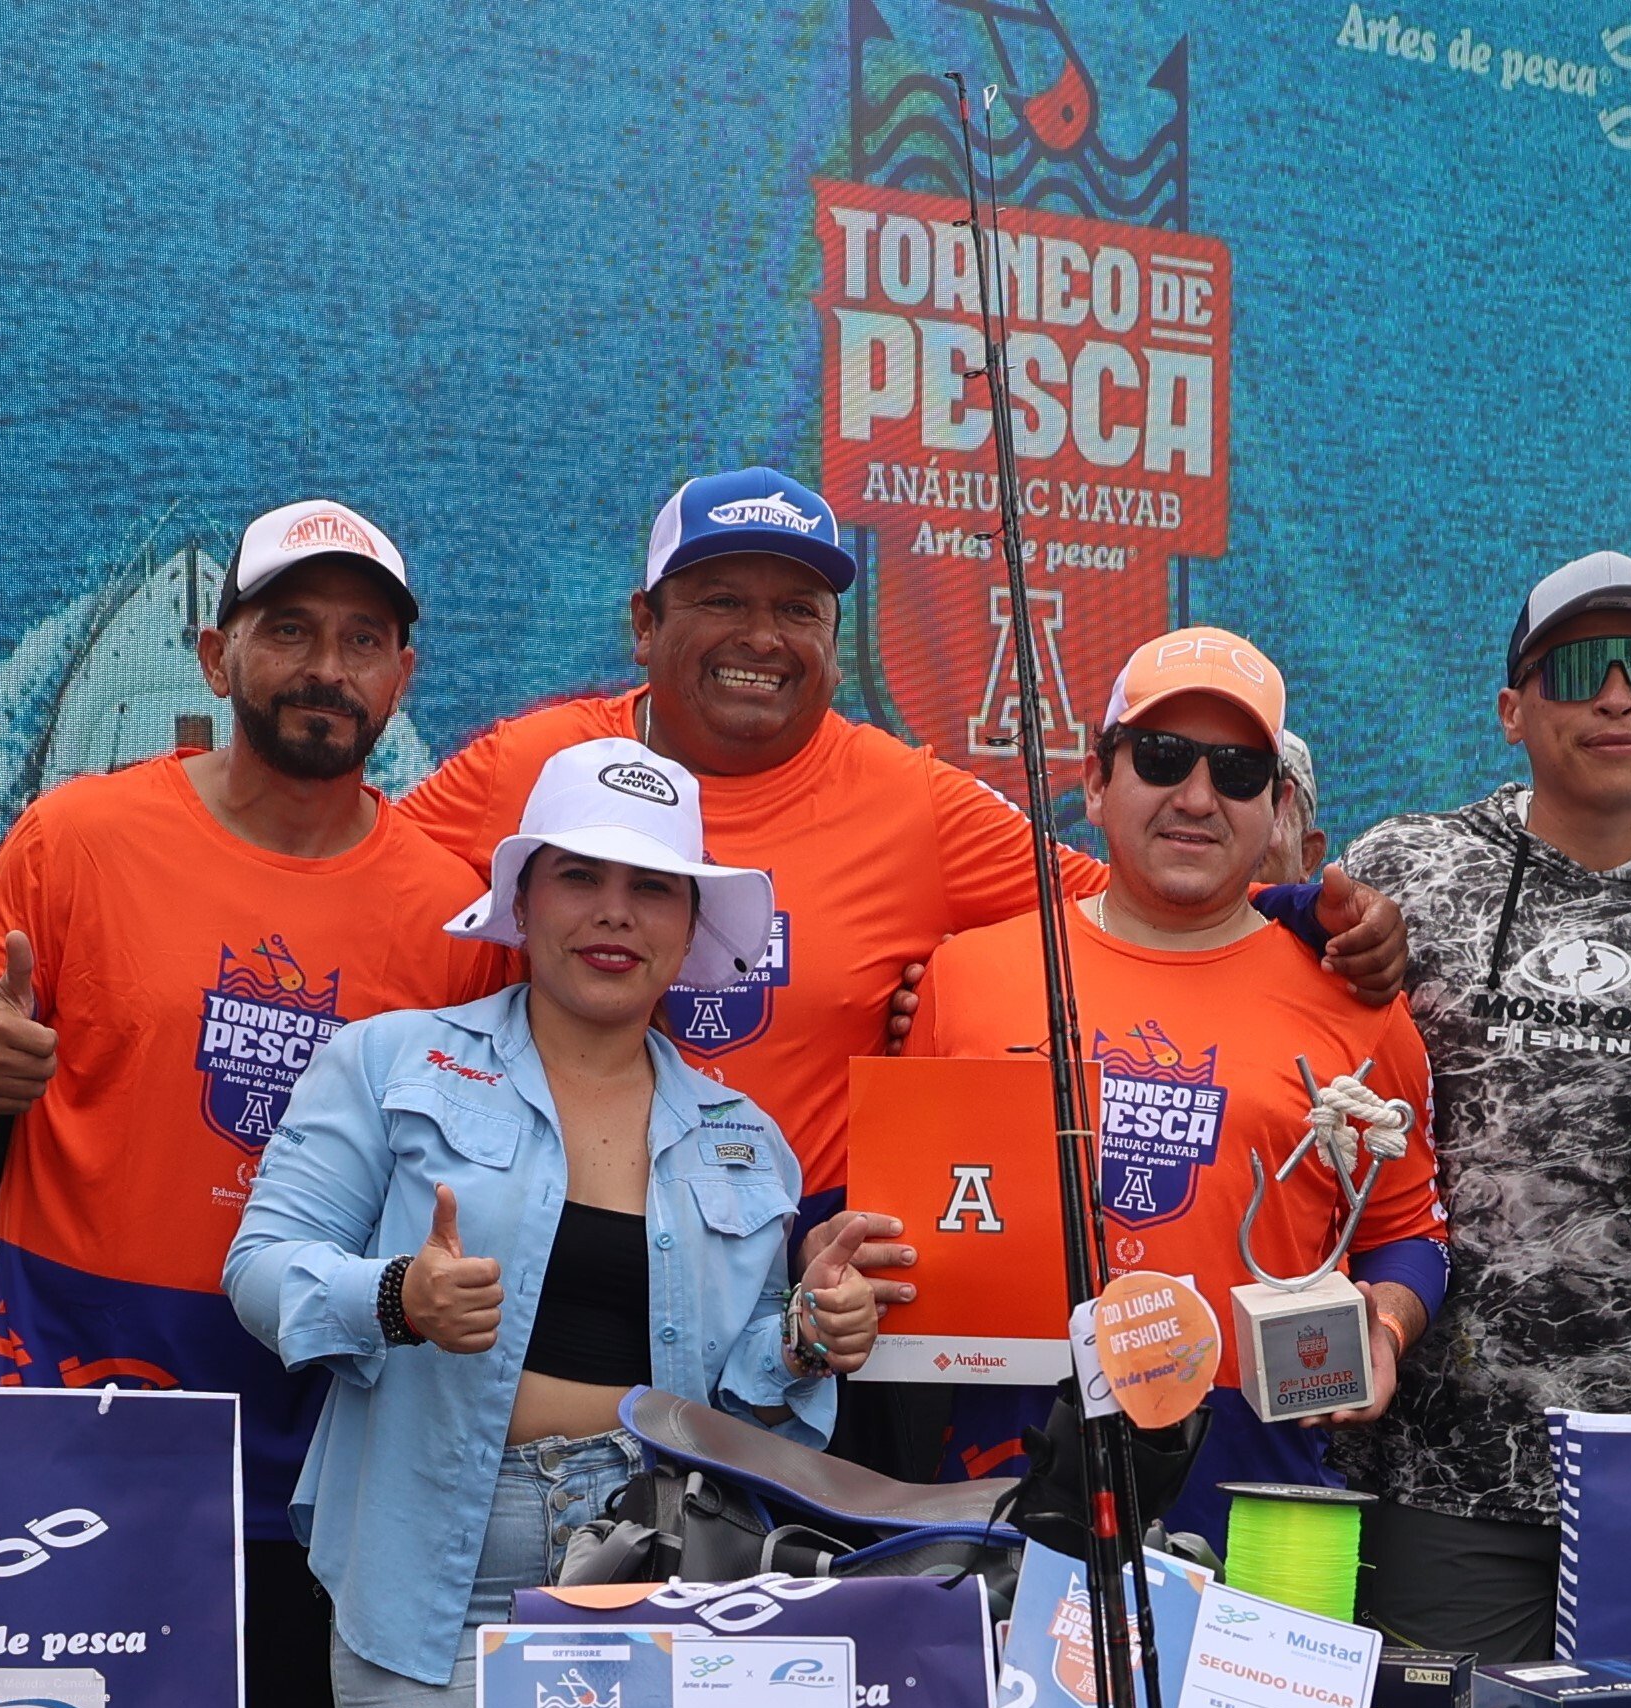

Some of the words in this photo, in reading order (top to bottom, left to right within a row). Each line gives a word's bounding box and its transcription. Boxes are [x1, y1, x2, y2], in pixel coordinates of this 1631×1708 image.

[1337, 3, 1436, 71] Artes
[1447, 25, 1493, 78] de
[830, 207, 1139, 333] TORNEO
[1150, 270, 1214, 327] DE
[832, 308, 1213, 477] PESCA
[742, 505, 809, 534] MUSTAD
[1059, 480, 1182, 530] MAYAB
[911, 522, 993, 560] Artes
[1156, 636, 1265, 685] PFG
[617, 767, 656, 784] LAND
[620, 777, 666, 799] ROVER
[209, 996, 315, 1037] TORNEO
[686, 998, 730, 1038] A
[1471, 994, 1601, 1028] MOSSY
[209, 1056, 273, 1079] ANÁHUAC
[1154, 1144, 1199, 1158] MAYAB
[936, 1164, 1005, 1235] A
[1114, 1166, 1156, 1213] A
[1125, 1288, 1176, 1318] LUGAR
[1109, 1317, 1182, 1355] OFFSHORE
[954, 1352, 1007, 1367] Anáhuac
[1277, 1382, 1359, 1406] OFFSHORE
[1301, 1370, 1354, 1390] LUGAR
[41, 1629, 147, 1661] pesca
[1286, 1631, 1363, 1664] Mustad
[1198, 1653, 1288, 1689] SEGUNDO
[1292, 1681, 1354, 1708] LUGAR
[1210, 1699, 1222, 1708] ES
